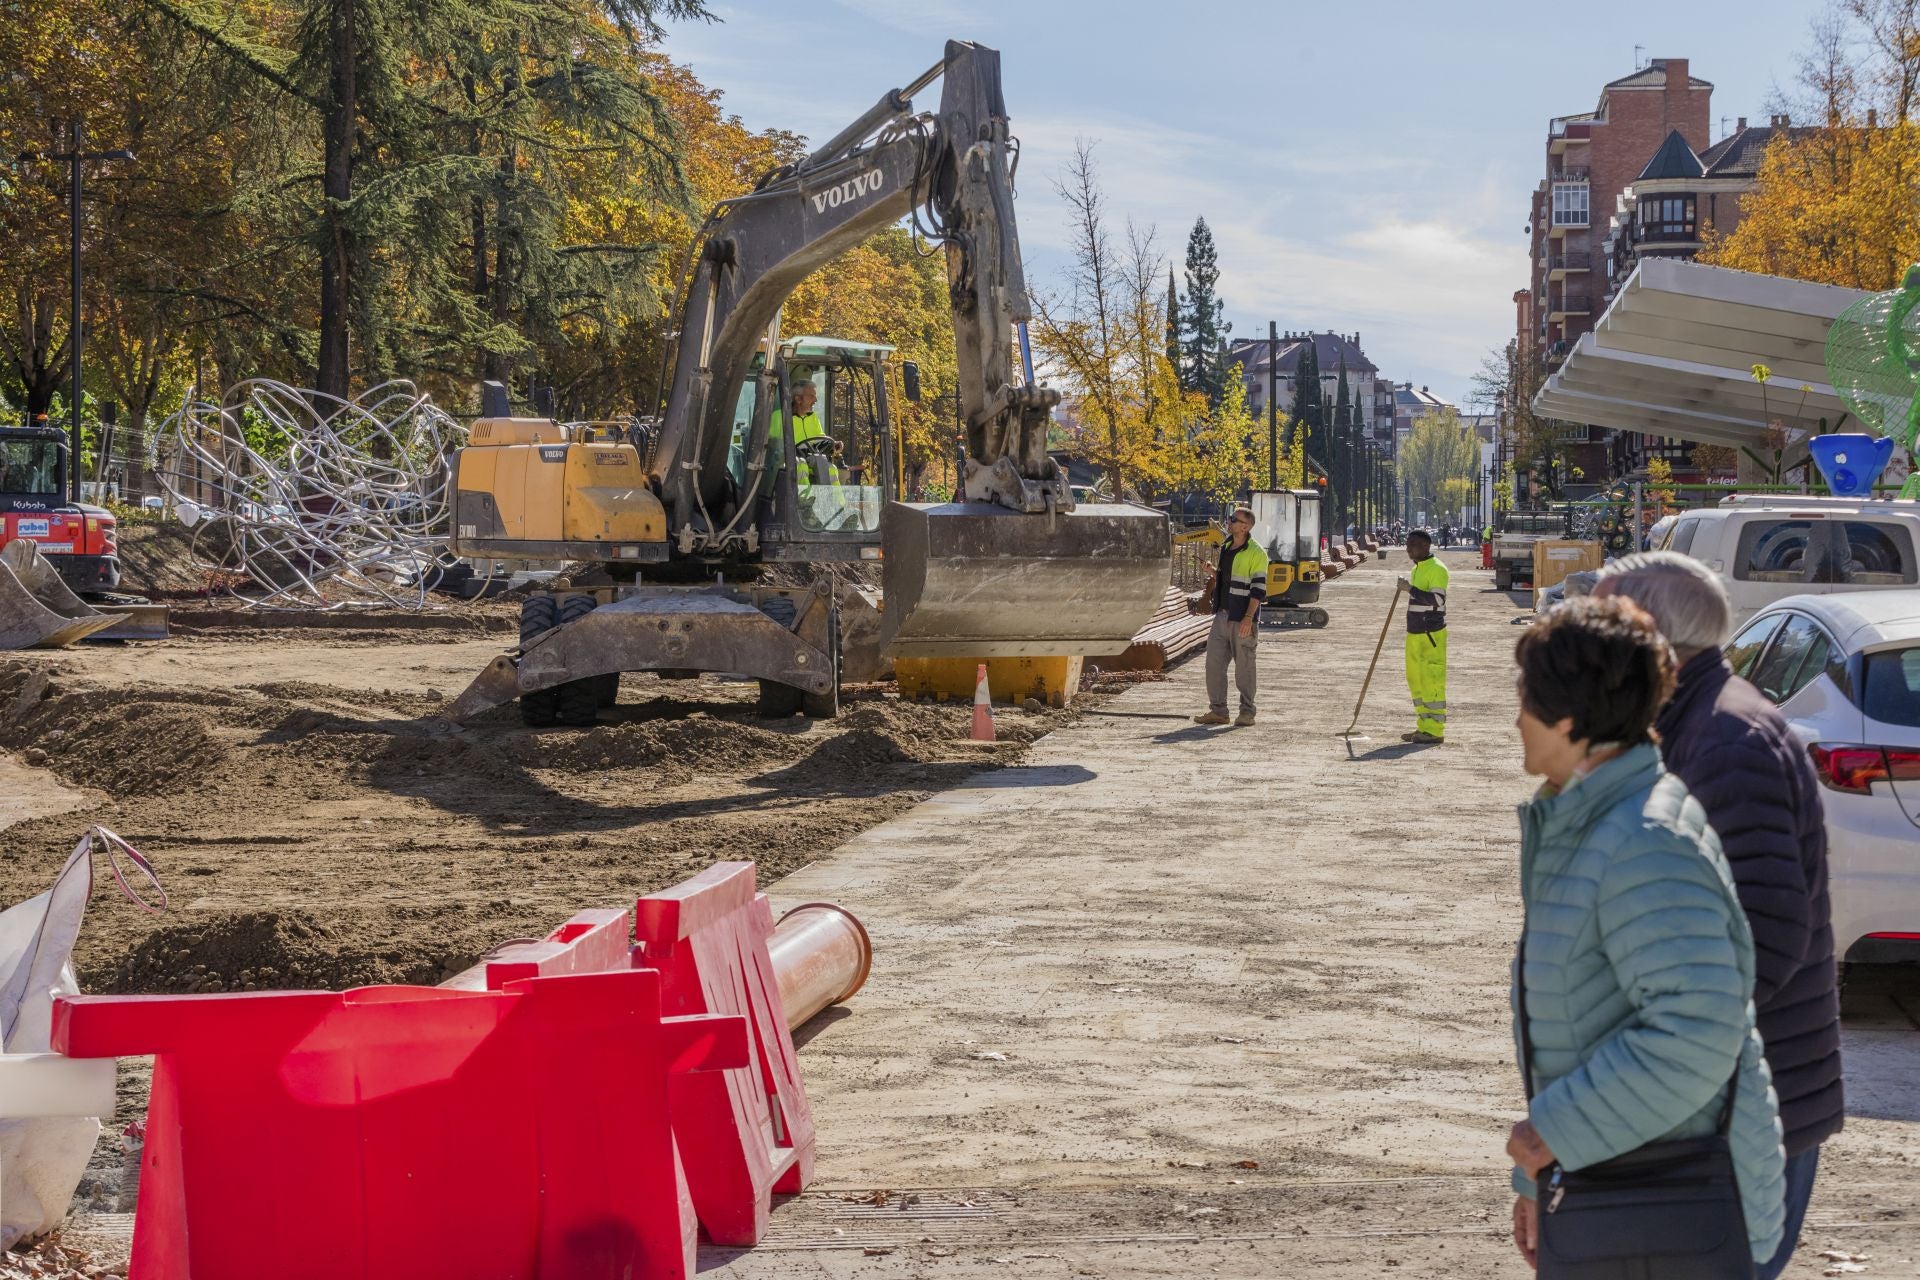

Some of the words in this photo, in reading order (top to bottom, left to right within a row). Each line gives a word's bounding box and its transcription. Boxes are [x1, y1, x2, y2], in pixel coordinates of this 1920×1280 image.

[812, 169, 883, 214] VOLVO
[545, 450, 564, 458] VOLVO
[13, 501, 46, 509] Kubota
[19, 522, 48, 531] rubel
